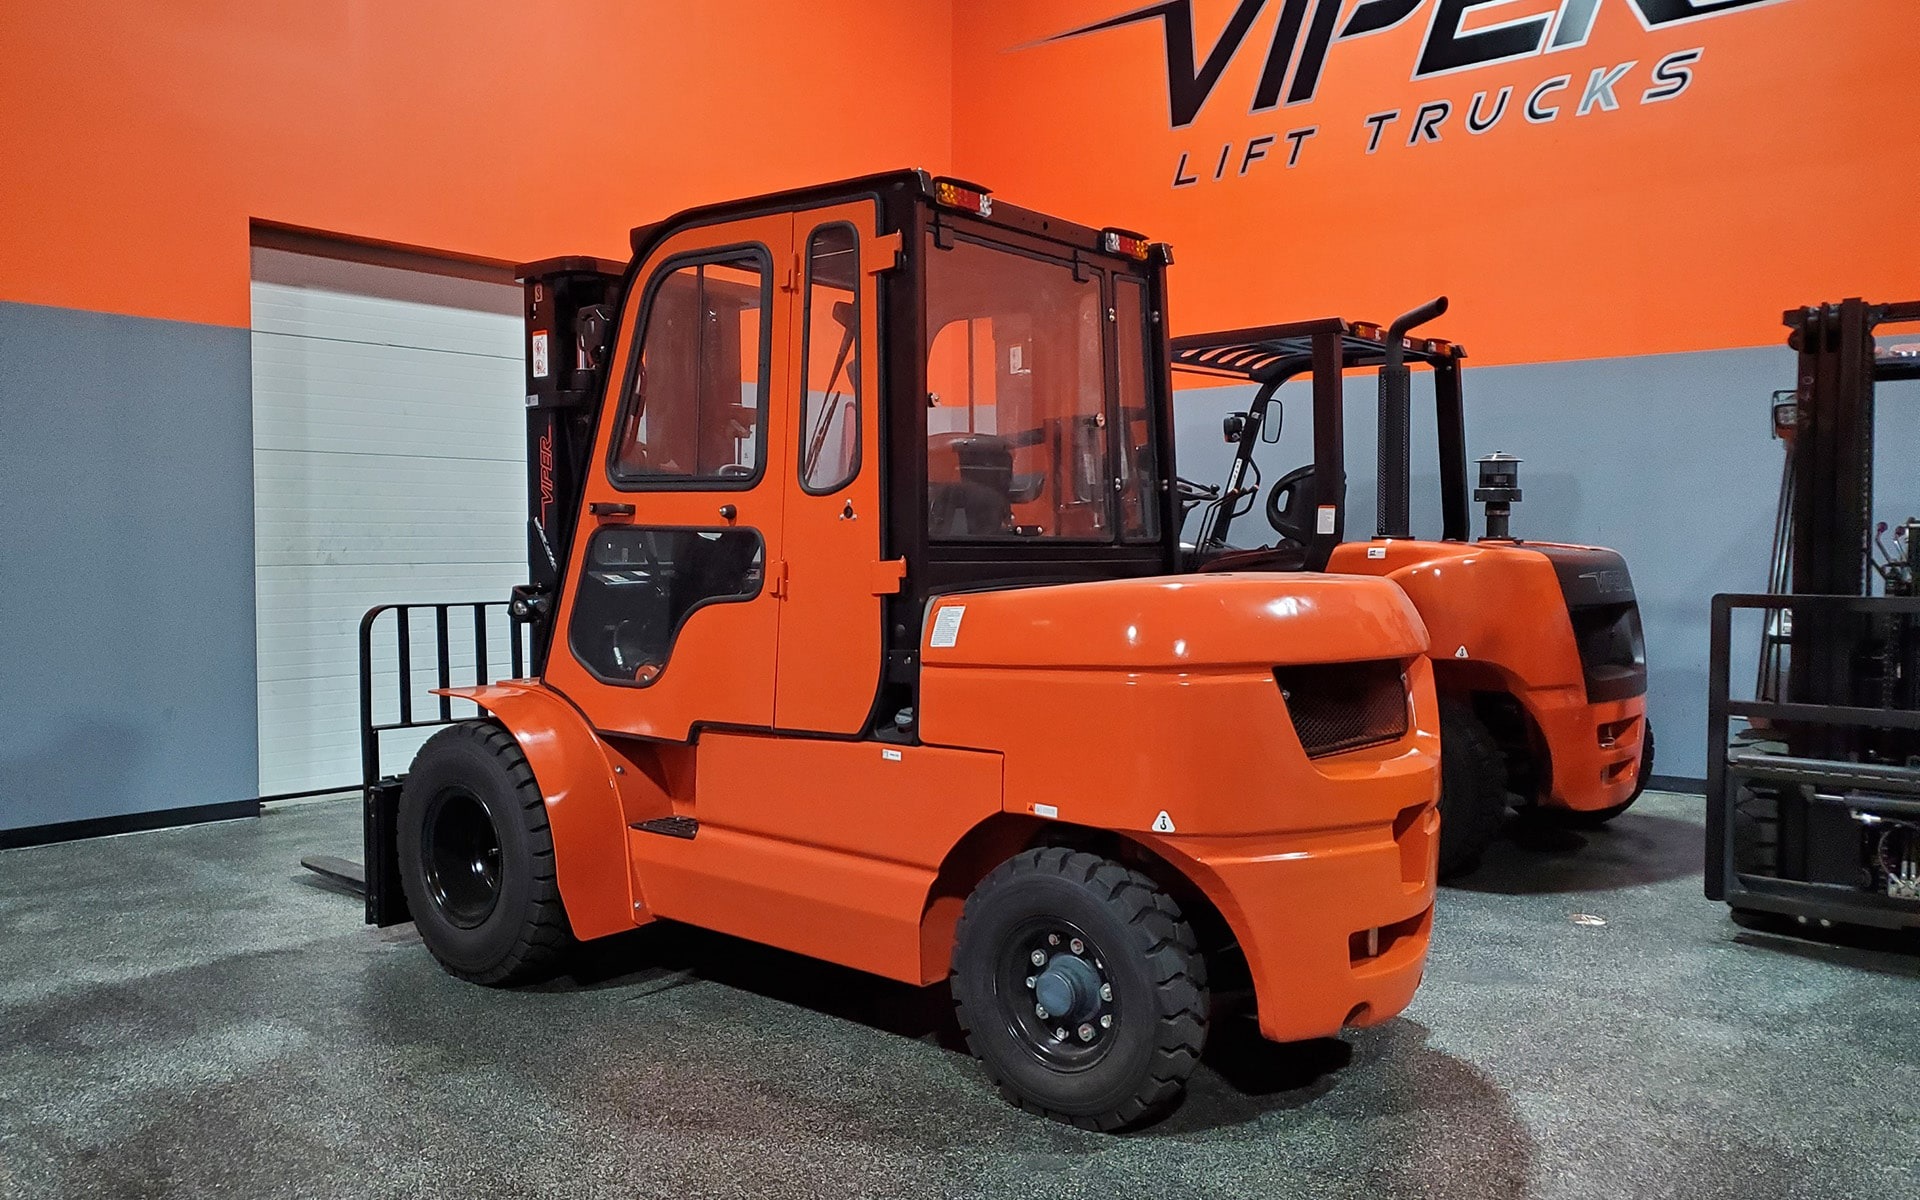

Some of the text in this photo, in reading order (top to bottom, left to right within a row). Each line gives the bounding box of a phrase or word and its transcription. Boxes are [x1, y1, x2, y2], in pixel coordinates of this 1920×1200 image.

[1171, 47, 1704, 188] LIFT TRUCKS
[540, 425, 553, 529] VIPER
